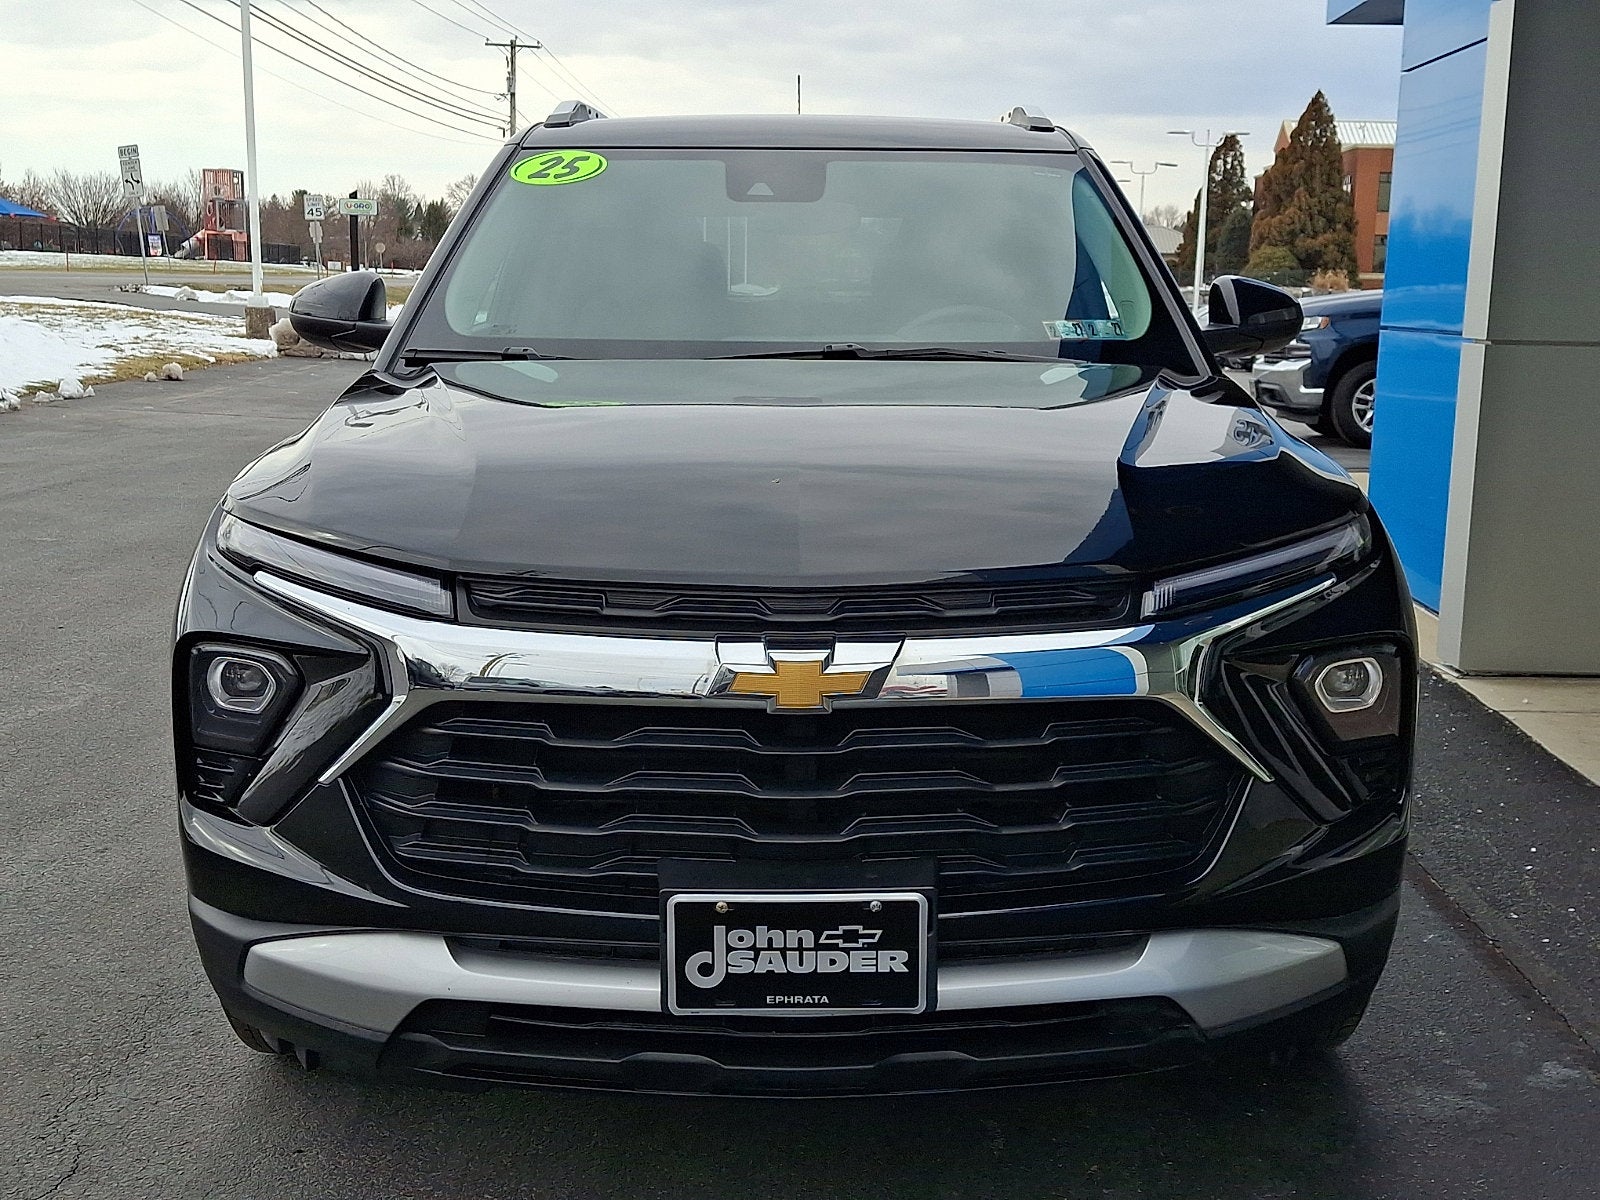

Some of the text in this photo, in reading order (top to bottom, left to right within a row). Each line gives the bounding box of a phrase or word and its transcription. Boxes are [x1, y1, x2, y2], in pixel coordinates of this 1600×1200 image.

[527, 156, 591, 179] 25
[307, 208, 322, 217] 45
[685, 925, 815, 989] John
[727, 950, 909, 974] SAUDER
[766, 995, 830, 1005] EPHRATA
